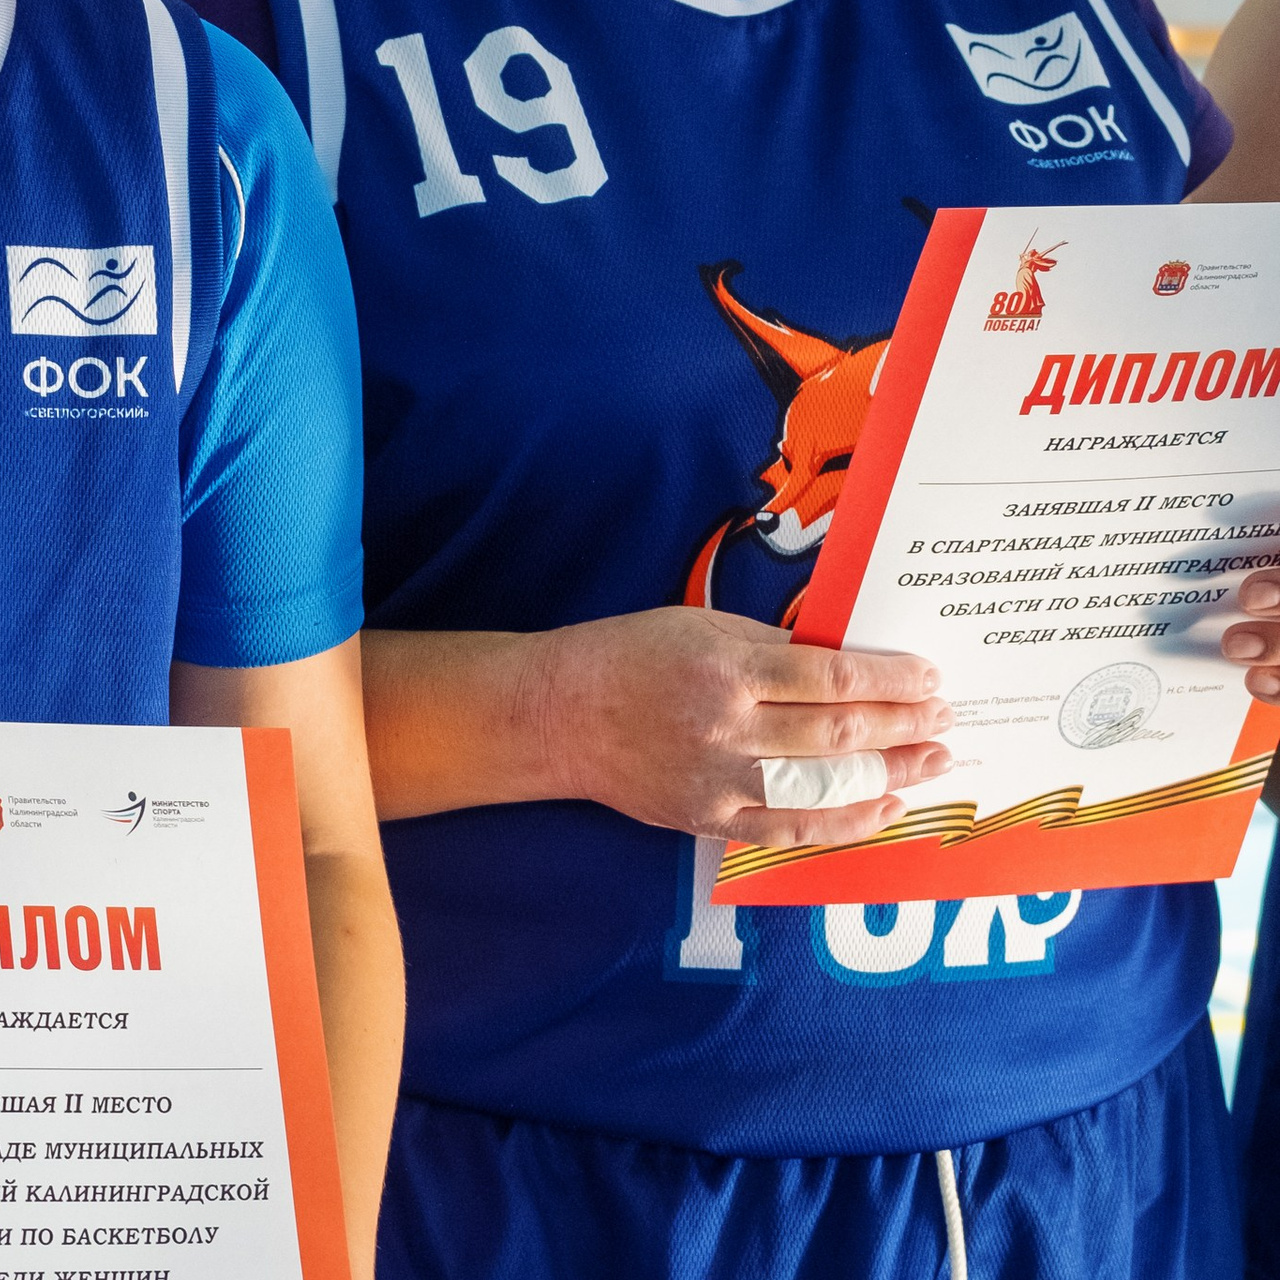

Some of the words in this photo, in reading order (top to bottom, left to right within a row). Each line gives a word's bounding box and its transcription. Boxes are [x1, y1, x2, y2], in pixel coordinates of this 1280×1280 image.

[375, 25, 609, 218] 19
[1009, 104, 1128, 153] ФОК
[1193, 272, 1258, 283] Калининградской
[1197, 263, 1252, 272] Правительство
[1190, 282, 1220, 291] области
[990, 291, 1023, 315] 80
[983, 319, 1041, 333] ПОБЕДА!
[23, 356, 149, 399] ФОК
[1018, 347, 1280, 415] ДИПЛОМ
[1043, 430, 1228, 452] НАГРАЖДАЕТСЯ
[1002, 499, 1131, 518] ЗАНЯВШАЯ
[1158, 493, 1235, 510] МЕСТО
[907, 541, 924, 554] В
[930, 532, 1095, 555] СПАРТАКИАДЕ
[1098, 523, 1280, 547] МУНИЦИПАЛЬНЫ
[897, 563, 1066, 587] ОБРАЗОВАНИЙ
[939, 598, 1042, 618] ОБЛАСТИ
[1047, 595, 1079, 612] ПО
[1083, 588, 1229, 609] БАСКЕТБОЛУ
[982, 628, 1055, 646] СРЕДИ
[1060, 622, 1171, 641] ЖЕНЩИН
[991, 694, 1061, 705] Правительства
[1188, 684, 1224, 694] Ищенко
[1012, 714, 1050, 724] области
[8, 796, 67, 806] Правительство
[152, 800, 210, 808] МИНИСТЕРСТВО
[9, 808, 78, 818] Калининградской
[10, 819, 42, 829] области
[91, 1095, 173, 1115] МЕСТО
[44, 1138, 264, 1163] МУНИЦИПАЛЬНЫХ
[25, 1177, 270, 1205] КАЛИНИНГРАДСКОЙ
[20, 1227, 54, 1246] ПО
[61, 1226, 219, 1247] БАСКЕТБОЛУ
